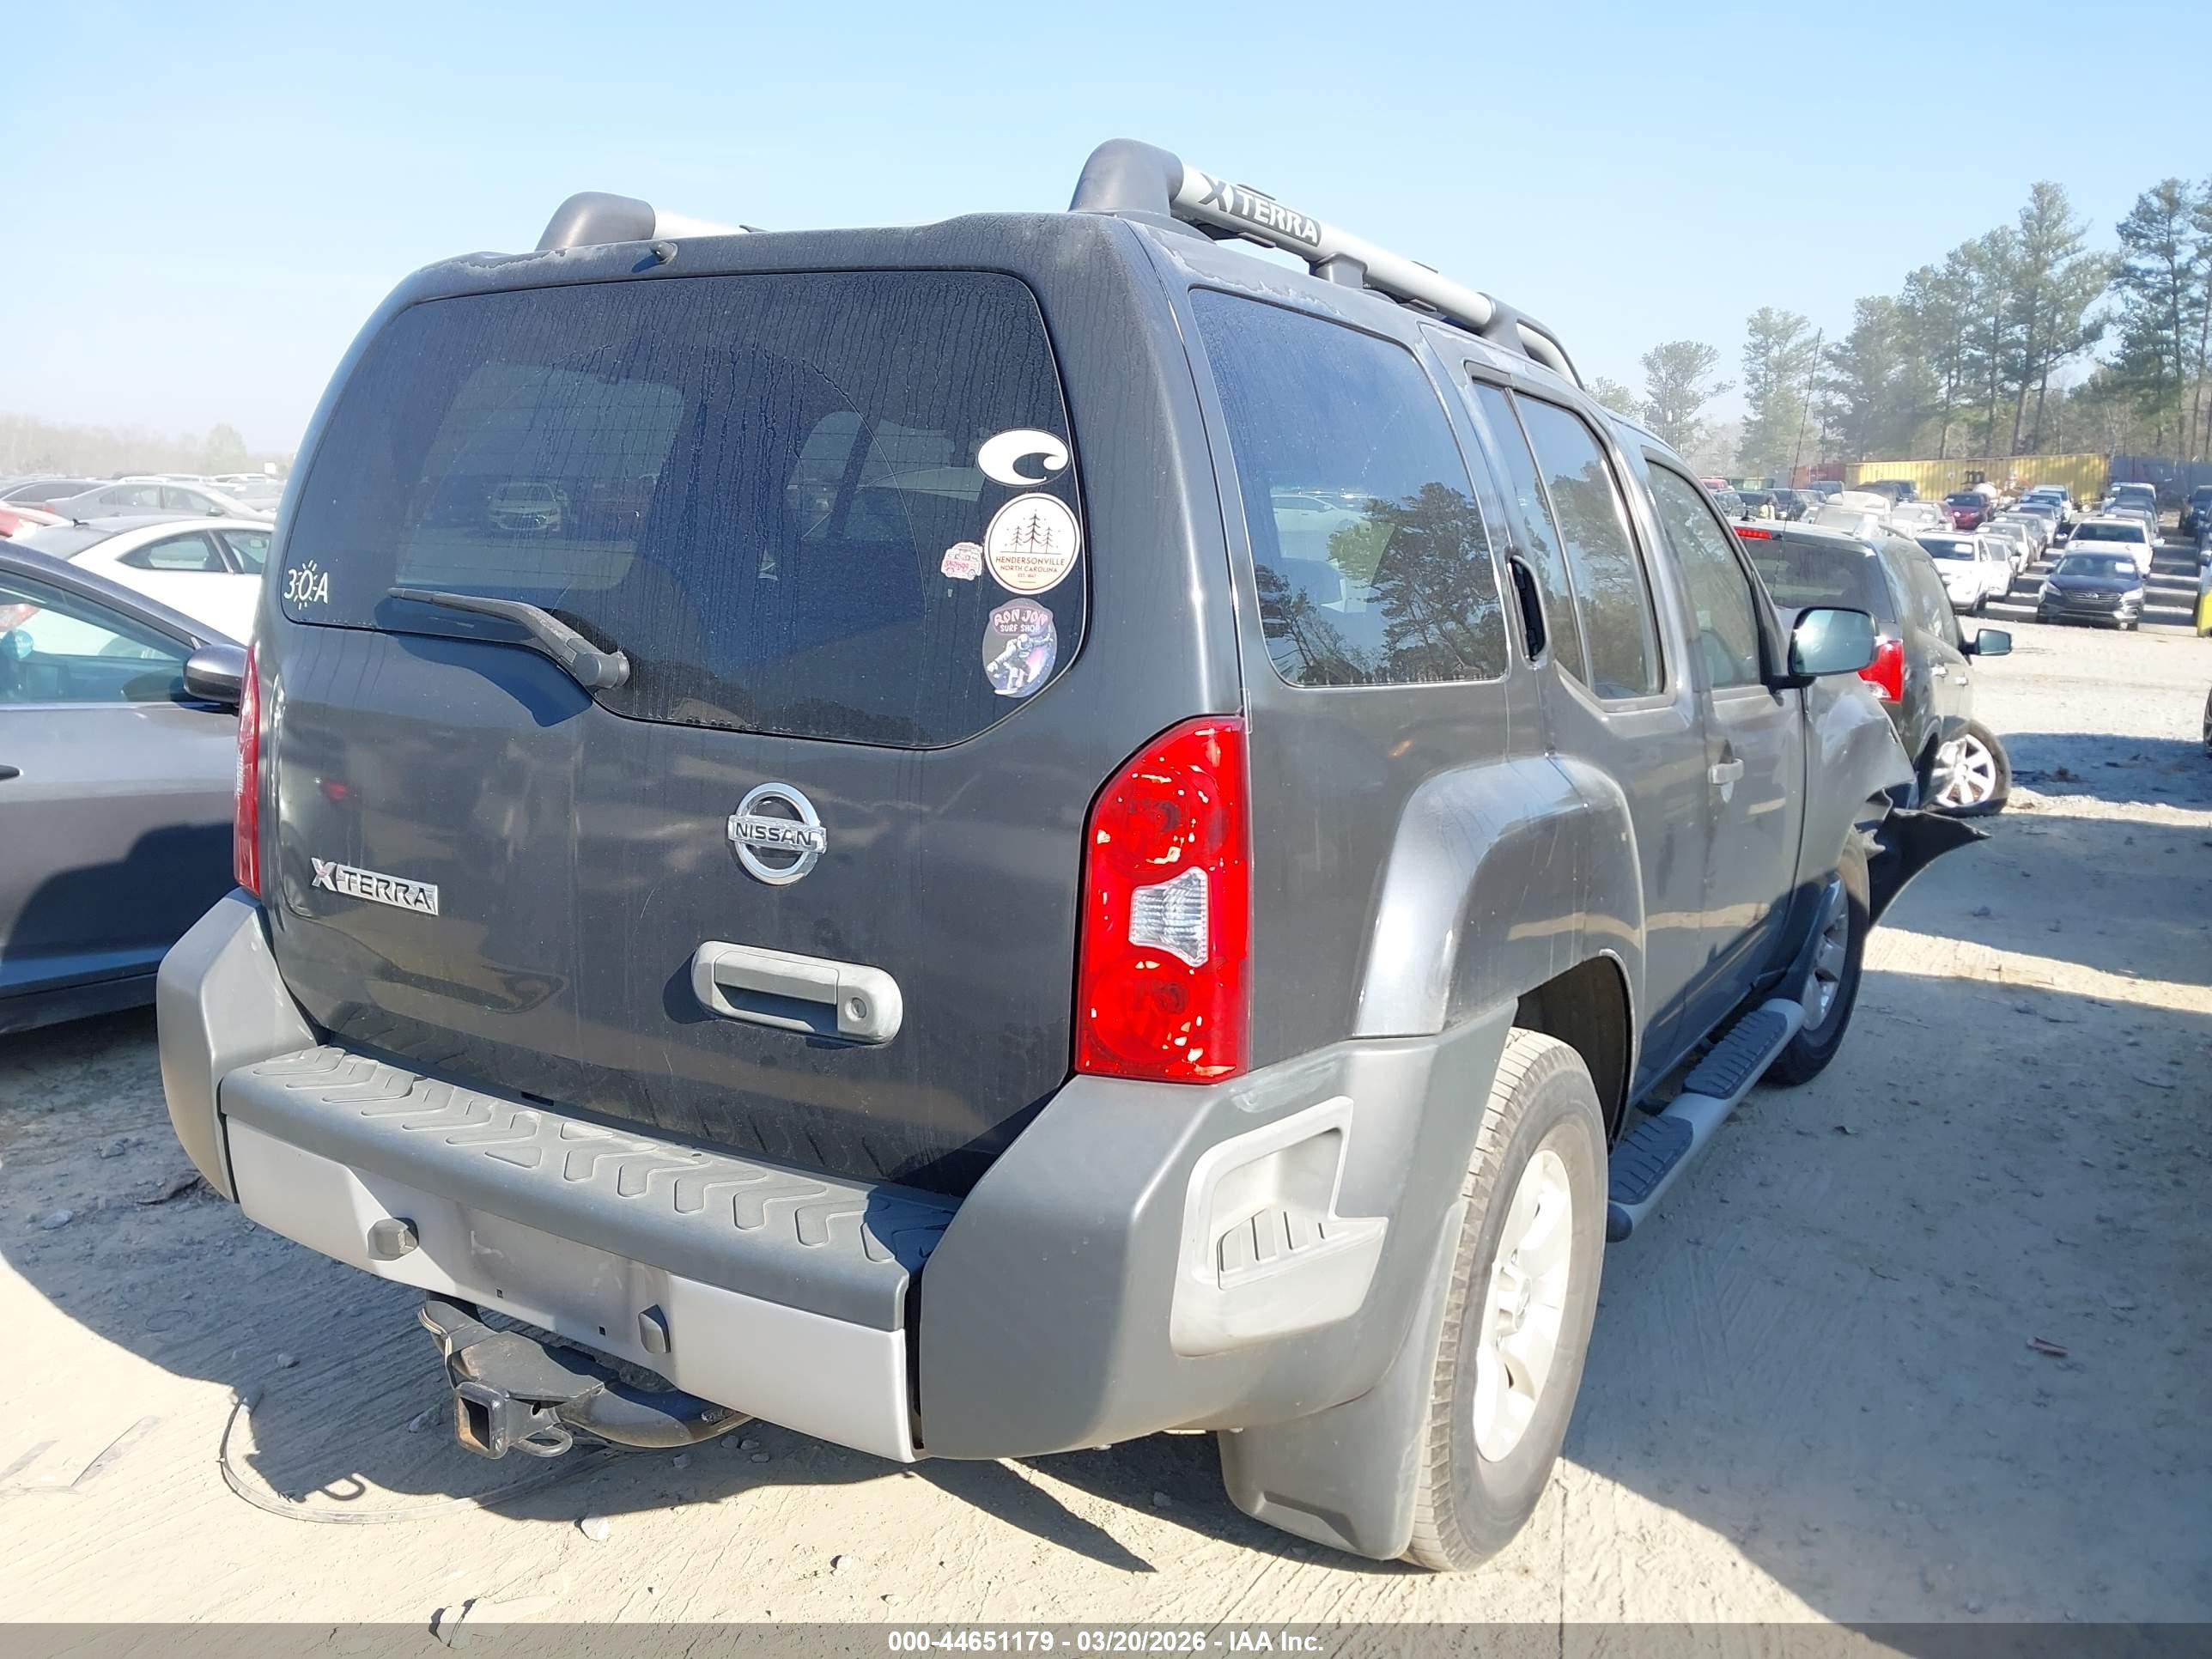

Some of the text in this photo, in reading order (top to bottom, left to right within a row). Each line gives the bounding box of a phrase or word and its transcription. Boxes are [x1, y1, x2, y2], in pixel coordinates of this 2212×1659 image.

[996, 556, 1066, 566] HENDERSONVILLE
[994, 609, 1048, 626] RON JON
[1020, 624, 1041, 633] SHOP
[736, 822, 811, 846] NISSAN
[311, 858, 437, 915] XTERRA
